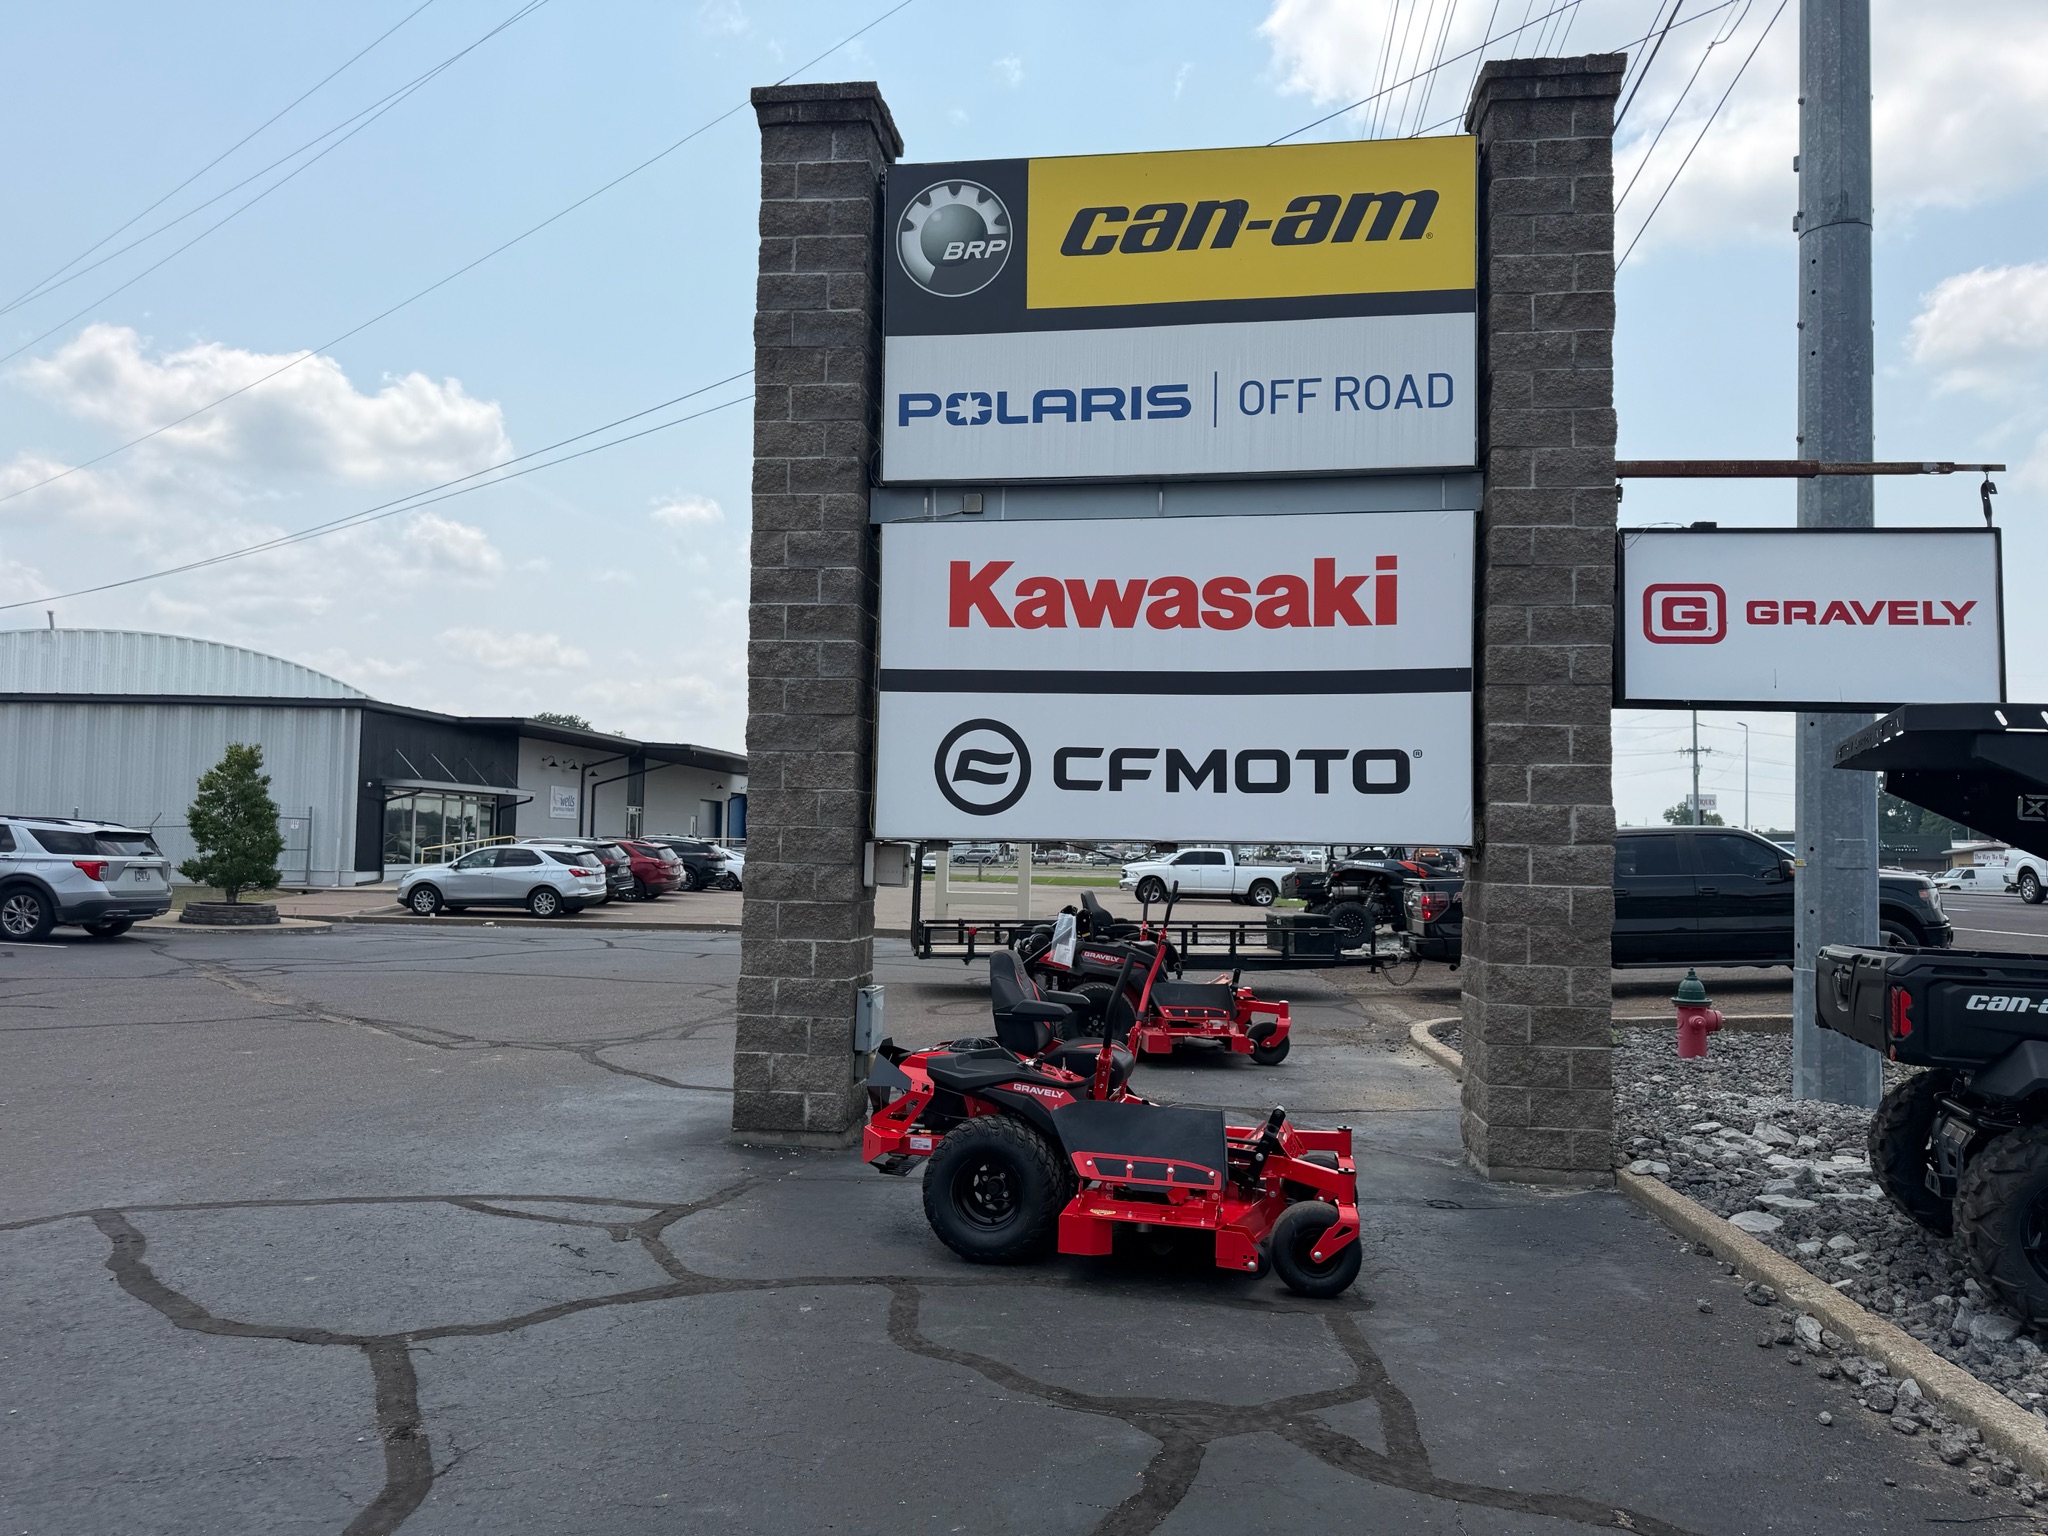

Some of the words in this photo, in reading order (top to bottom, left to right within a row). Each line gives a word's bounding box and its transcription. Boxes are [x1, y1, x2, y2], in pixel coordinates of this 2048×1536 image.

[1060, 189, 1440, 257] can-am
[942, 239, 1007, 261] BRP
[898, 384, 1192, 427] POLARIS
[1239, 377, 1323, 415] OFF
[1335, 372, 1454, 411] ROAD
[949, 555, 1398, 631] Kawasaki
[1746, 600, 1978, 626] GRAVELY
[1053, 747, 1411, 794] CFMOTO
[560, 795, 575, 807] wells
[1084, 951, 1120, 963] GRAVELY
[1013, 1083, 1064, 1099] GRAVELY
